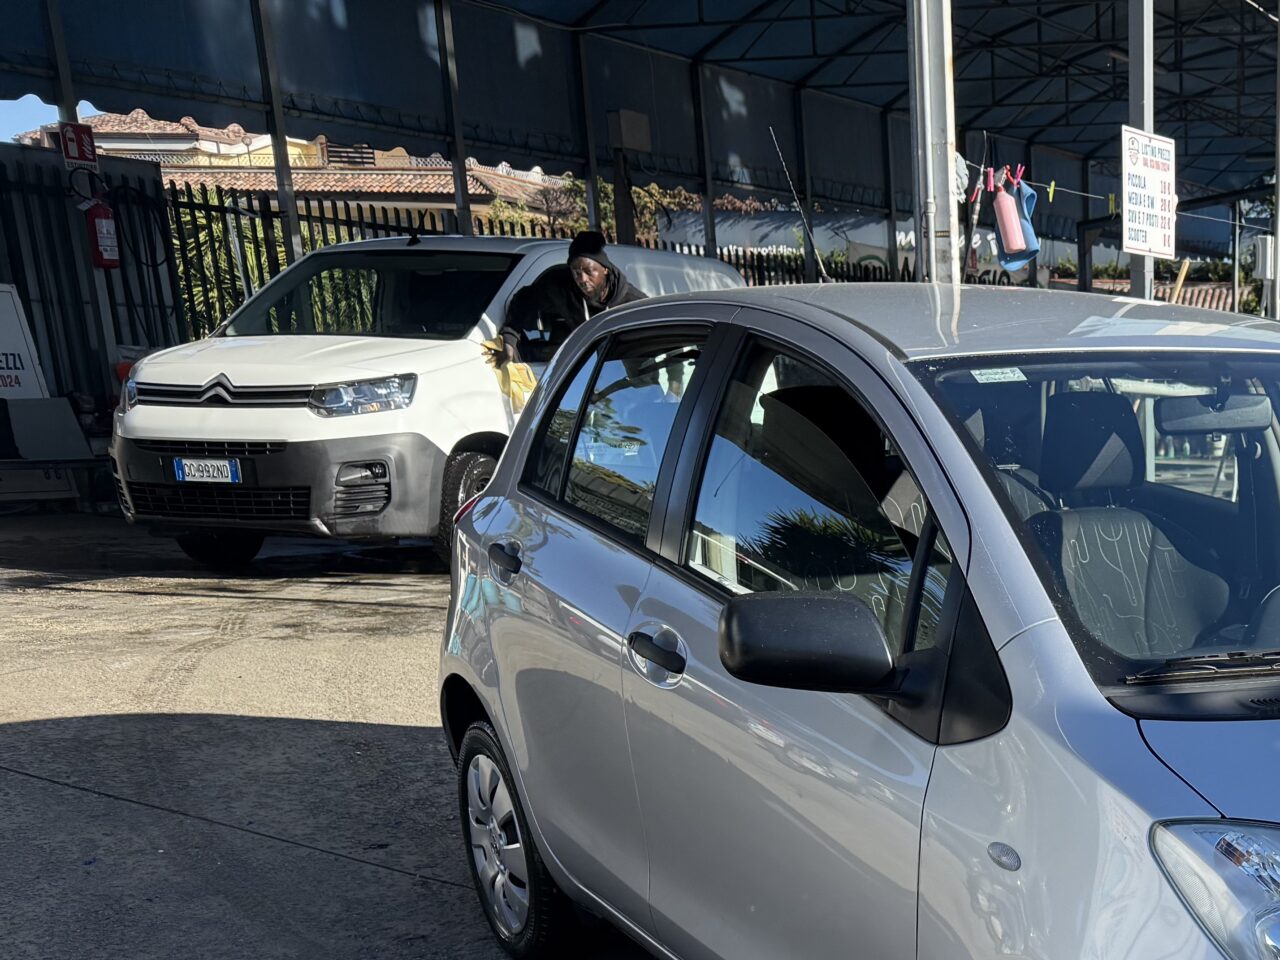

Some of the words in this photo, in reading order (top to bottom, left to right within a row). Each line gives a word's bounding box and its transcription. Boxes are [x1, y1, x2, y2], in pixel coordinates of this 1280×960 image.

[1141, 142, 1157, 158] LISTINO
[1128, 172, 1146, 190] PICCOLA
[1128, 191, 1142, 206] MEDIA
[1128, 209, 1137, 224] SUV
[1145, 212, 1159, 228] POSTI
[1160, 215, 1166, 230] 22
[1128, 226, 1148, 243] SCOOTER
